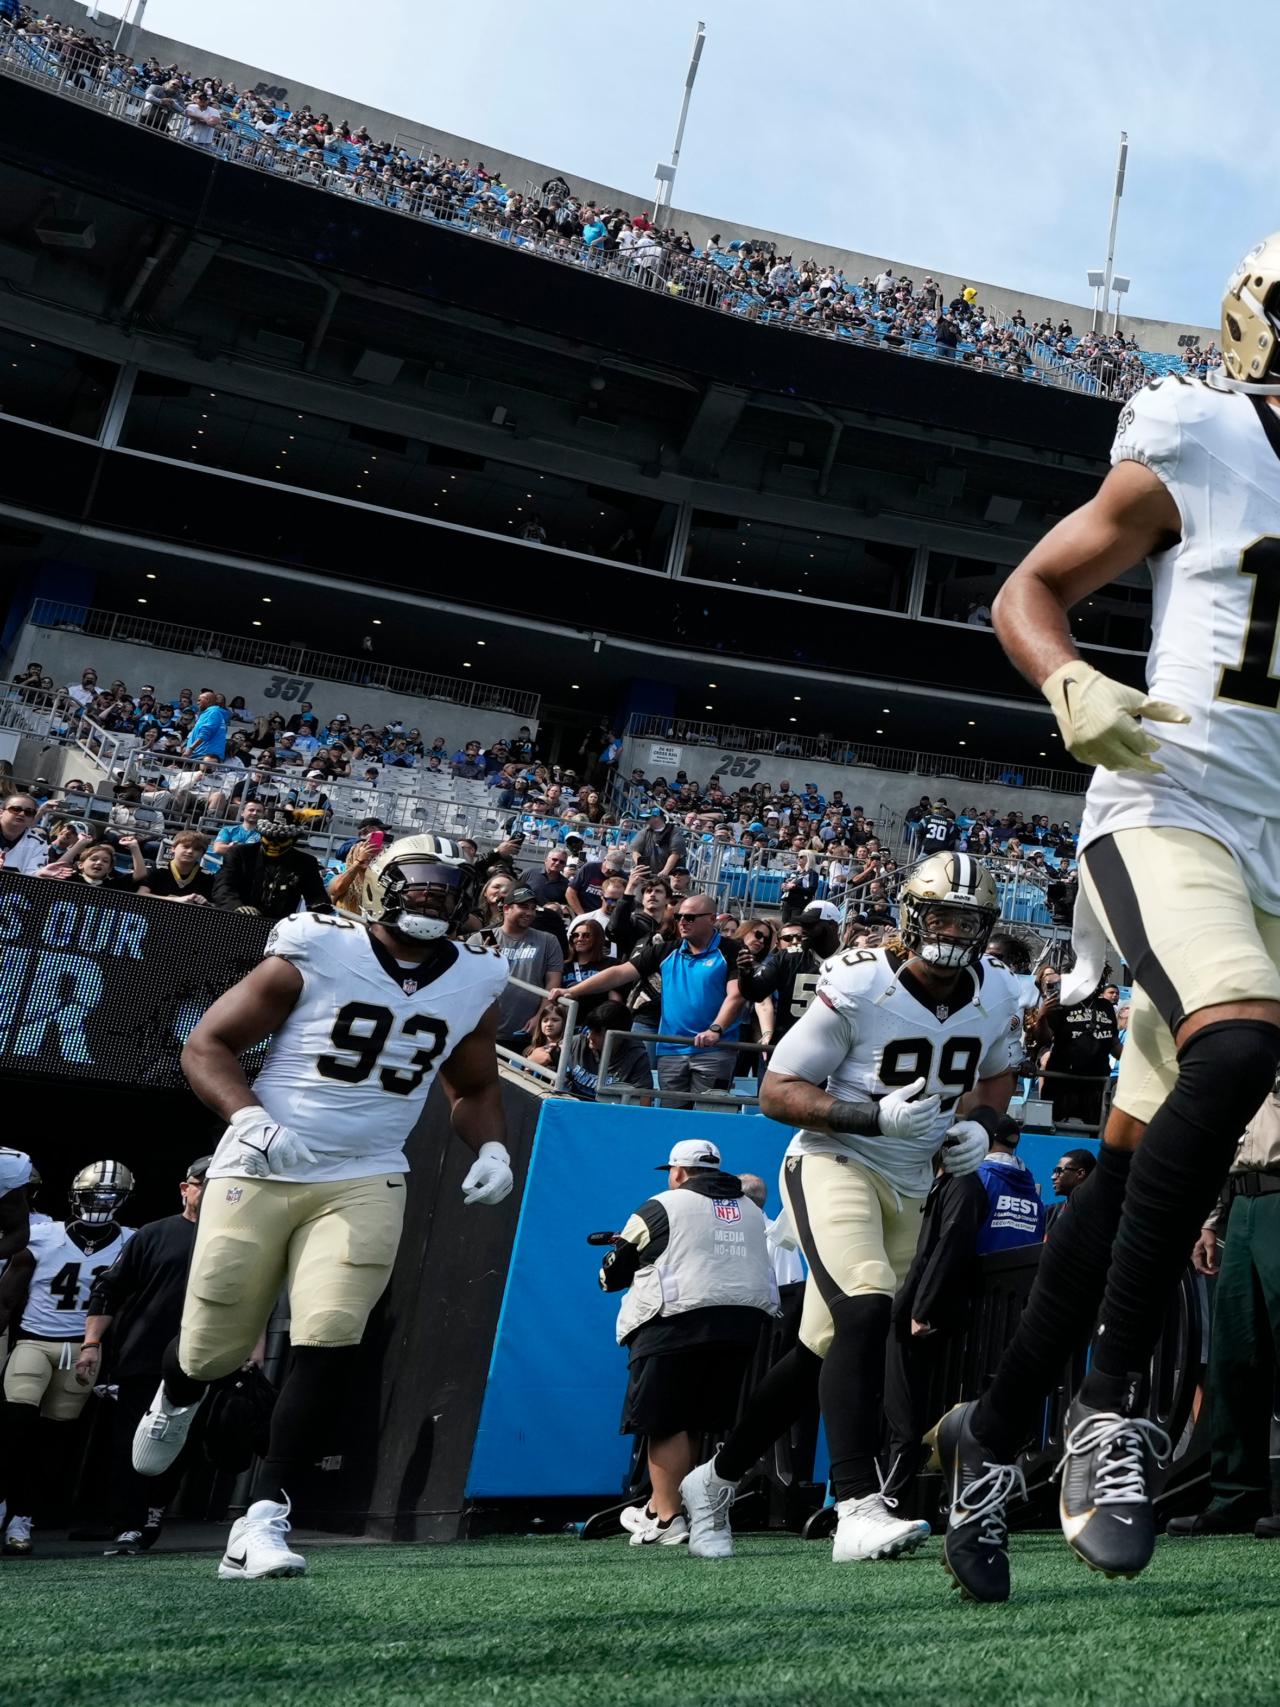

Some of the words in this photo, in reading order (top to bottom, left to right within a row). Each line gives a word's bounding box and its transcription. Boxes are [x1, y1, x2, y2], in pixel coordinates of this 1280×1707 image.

[264, 675, 314, 703] 351
[715, 755, 761, 778] 252
[925, 823, 947, 841] 30
[42, 900, 151, 960] OUR
[316, 1000, 450, 1096] 93
[875, 1036, 982, 1115] 99
[716, 1206, 739, 1220] NFL
[996, 1195, 1038, 1216] BEST
[714, 1230, 745, 1242] MEDIA
